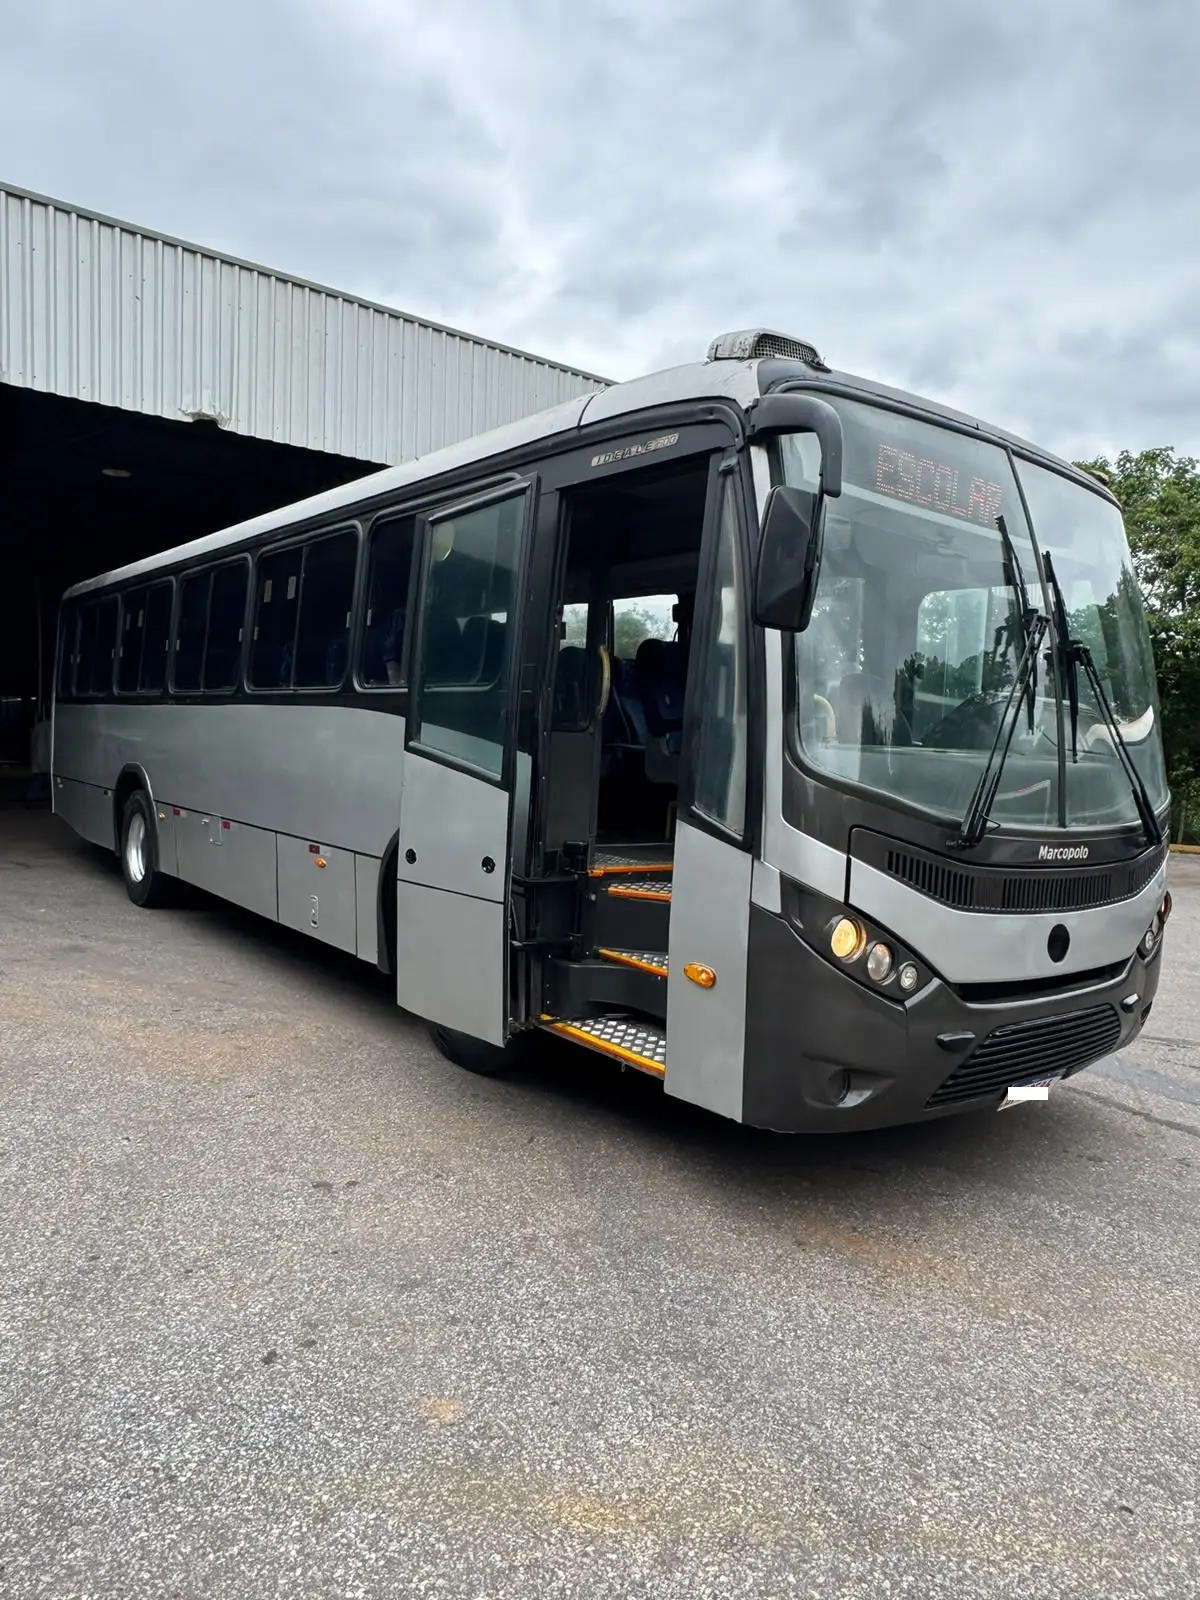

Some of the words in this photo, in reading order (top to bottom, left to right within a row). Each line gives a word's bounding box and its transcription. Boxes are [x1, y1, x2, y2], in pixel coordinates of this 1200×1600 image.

[595, 441, 655, 465] IDEALE
[876, 444, 1002, 526] ESCOLAR
[1038, 845, 1089, 860] Marcopolo
